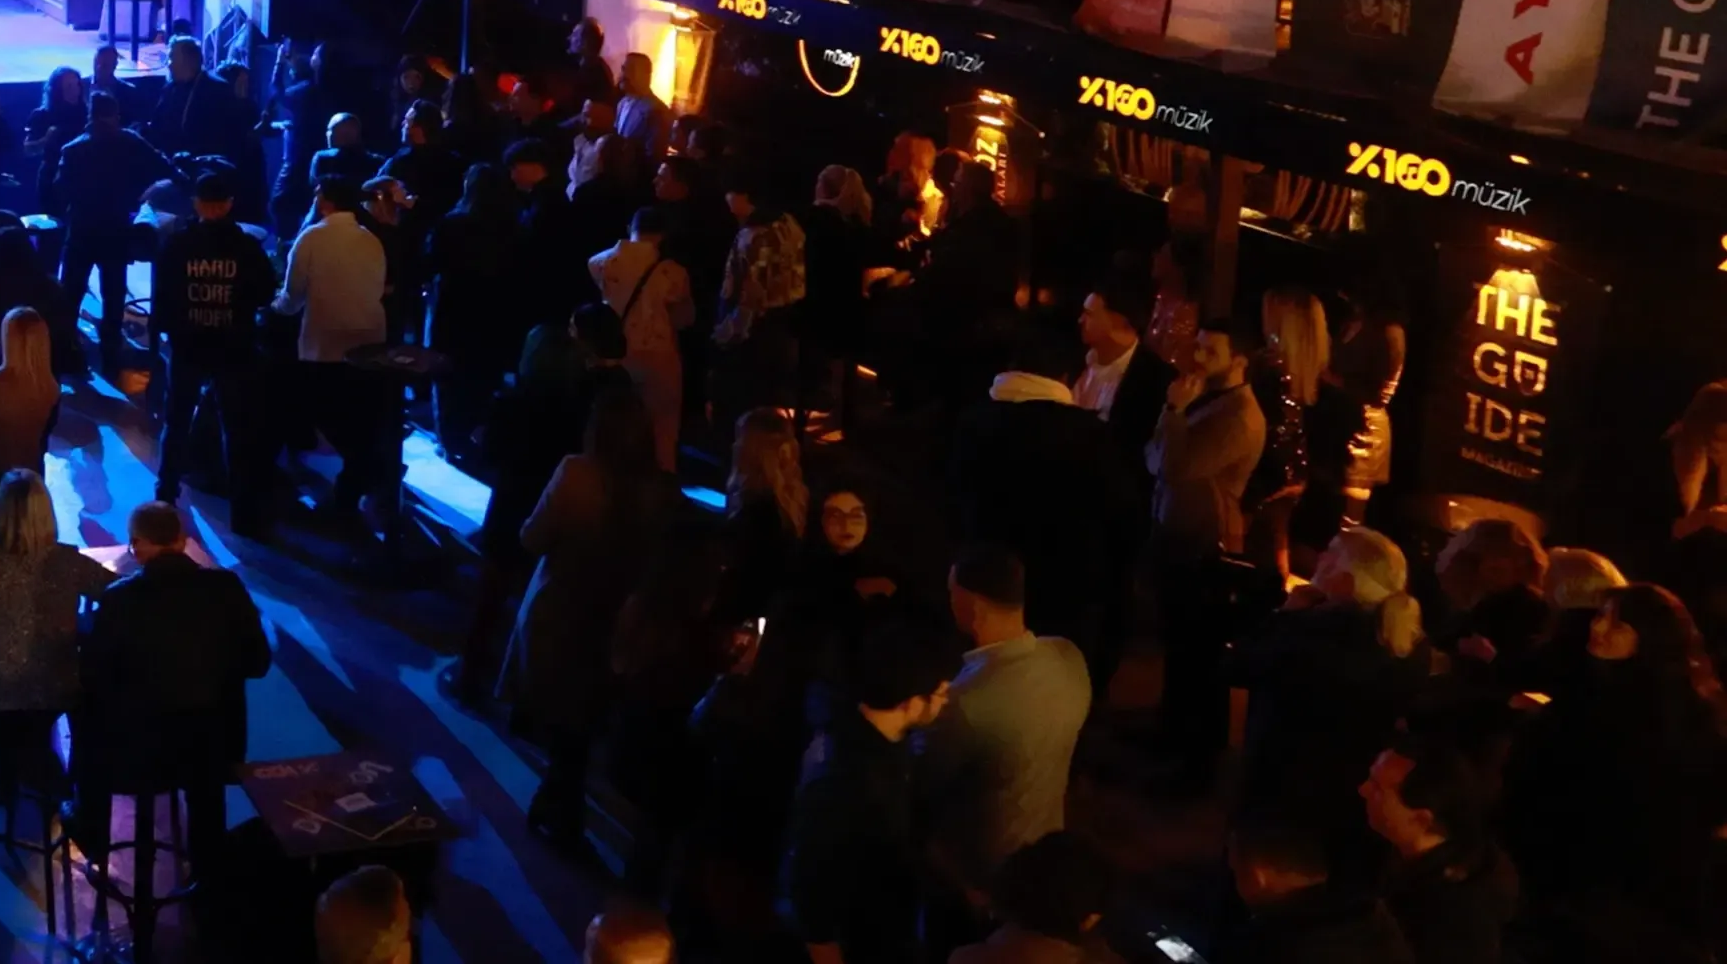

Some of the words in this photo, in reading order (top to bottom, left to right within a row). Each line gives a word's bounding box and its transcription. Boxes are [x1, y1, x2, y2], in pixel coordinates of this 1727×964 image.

[1636, 26, 1711, 130] THE
[1155, 105, 1214, 135] müzik
[1451, 179, 1533, 217] müzik
[186, 258, 237, 278] HARD
[187, 282, 234, 304] CORE
[1476, 283, 1562, 346] THE
[1464, 391, 1546, 457] IDE
